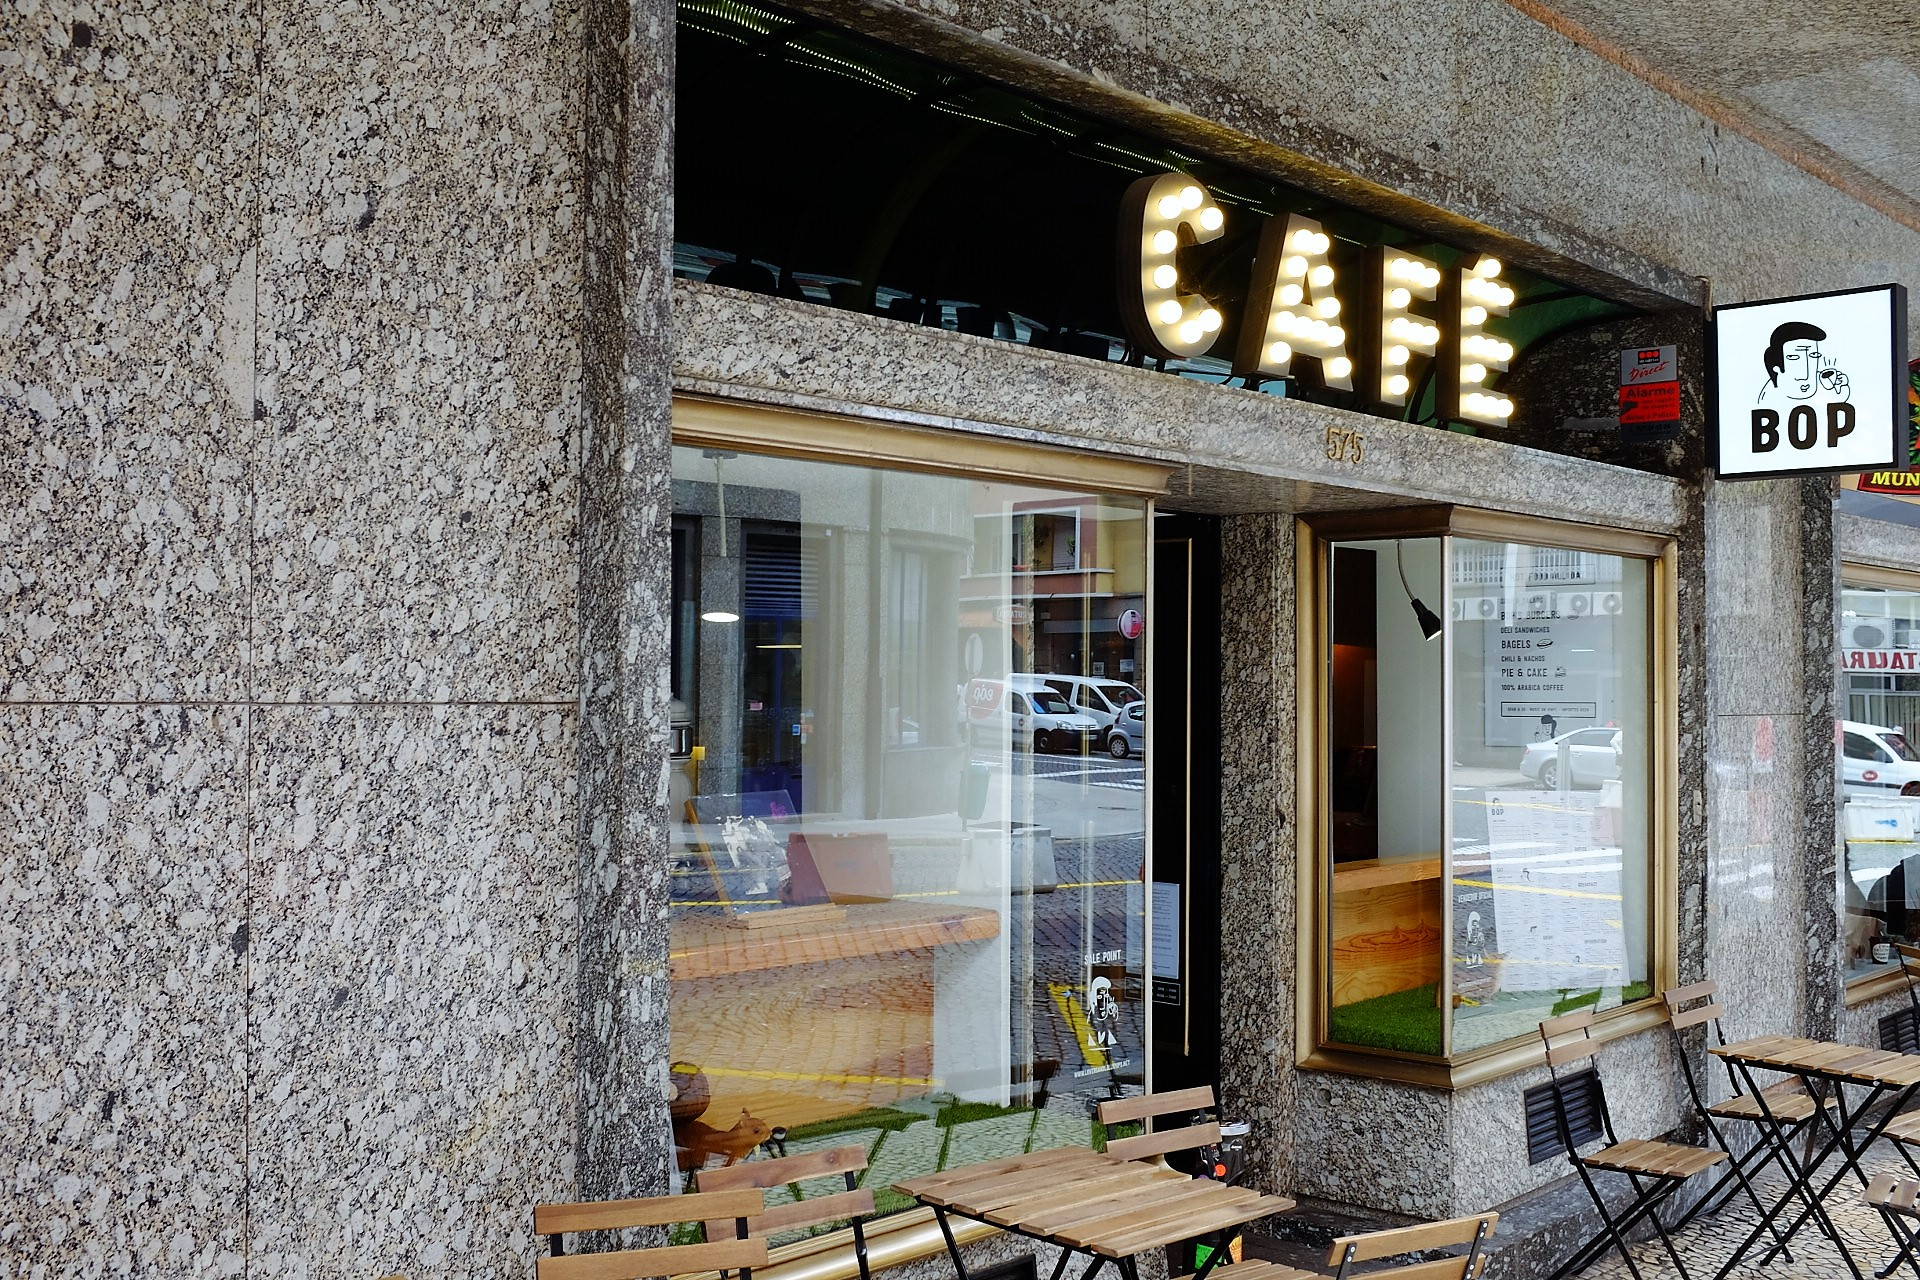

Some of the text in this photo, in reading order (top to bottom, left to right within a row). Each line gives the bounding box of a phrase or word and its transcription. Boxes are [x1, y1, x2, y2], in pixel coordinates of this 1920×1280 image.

[1116, 172, 1515, 429] CAFÉ
[1628, 361, 1670, 381] Direct
[1751, 402, 1856, 453] BOP
[1326, 426, 1365, 464] 575
[1500, 626, 1550, 634] DELI SANDWICHES
[1501, 640, 1531, 649] BAGELS
[1501, 668, 1548, 677] PIE & CAKE
[1084, 949, 1122, 966] SALE POINT
